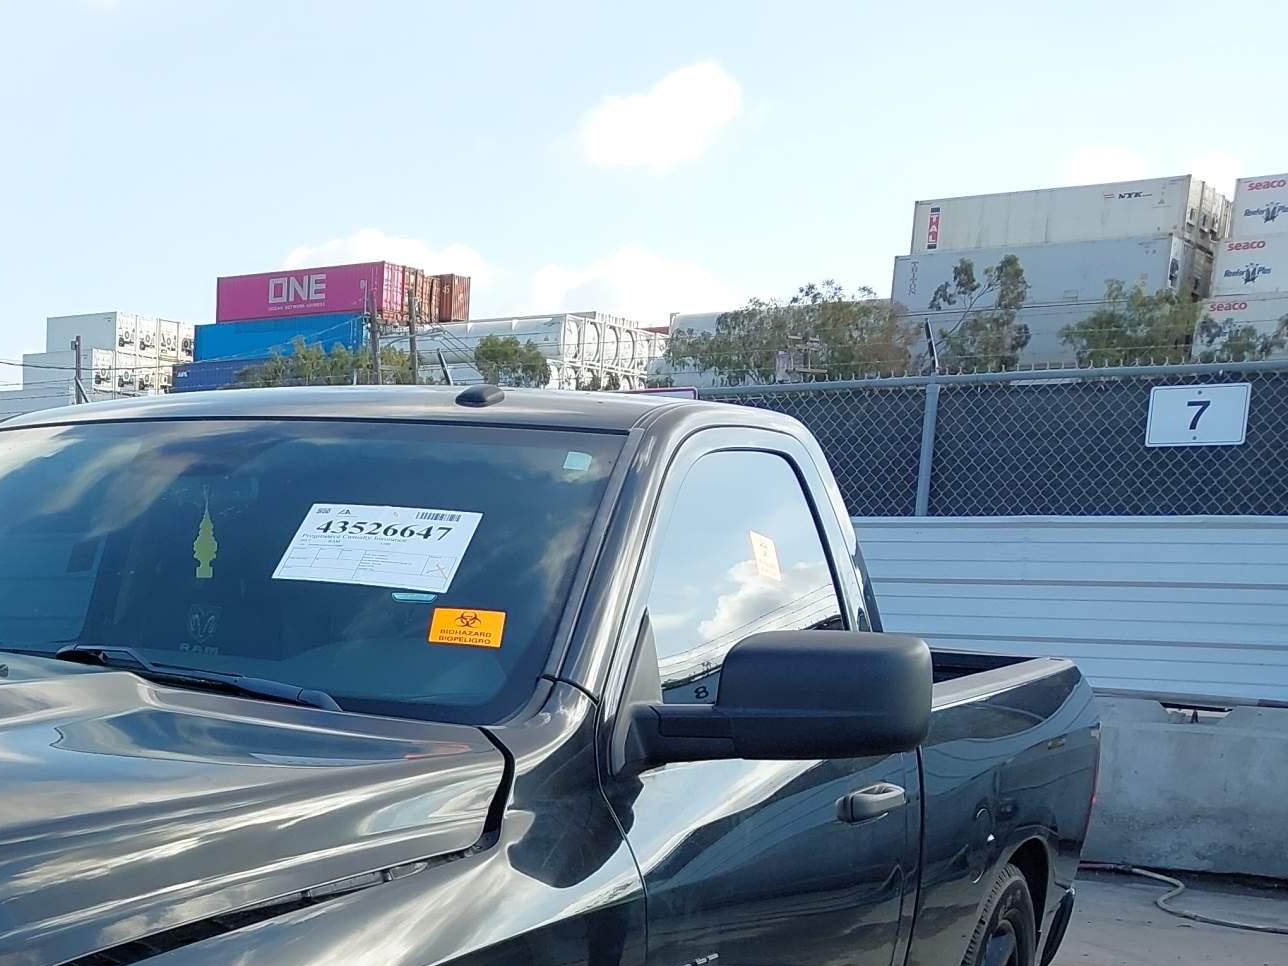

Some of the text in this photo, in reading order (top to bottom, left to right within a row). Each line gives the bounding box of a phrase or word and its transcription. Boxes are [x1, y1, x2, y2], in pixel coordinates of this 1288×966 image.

[1247, 178, 1287, 191] seaco
[1227, 239, 1266, 251] seaco
[268, 274, 327, 304] ONE
[1209, 301, 1248, 312] seaco
[1187, 401, 1211, 431] 7
[316, 520, 454, 541] 43526647
[439, 628, 492, 638] BIOHAZARD
[438, 635, 491, 645] BIOPELIGRO
